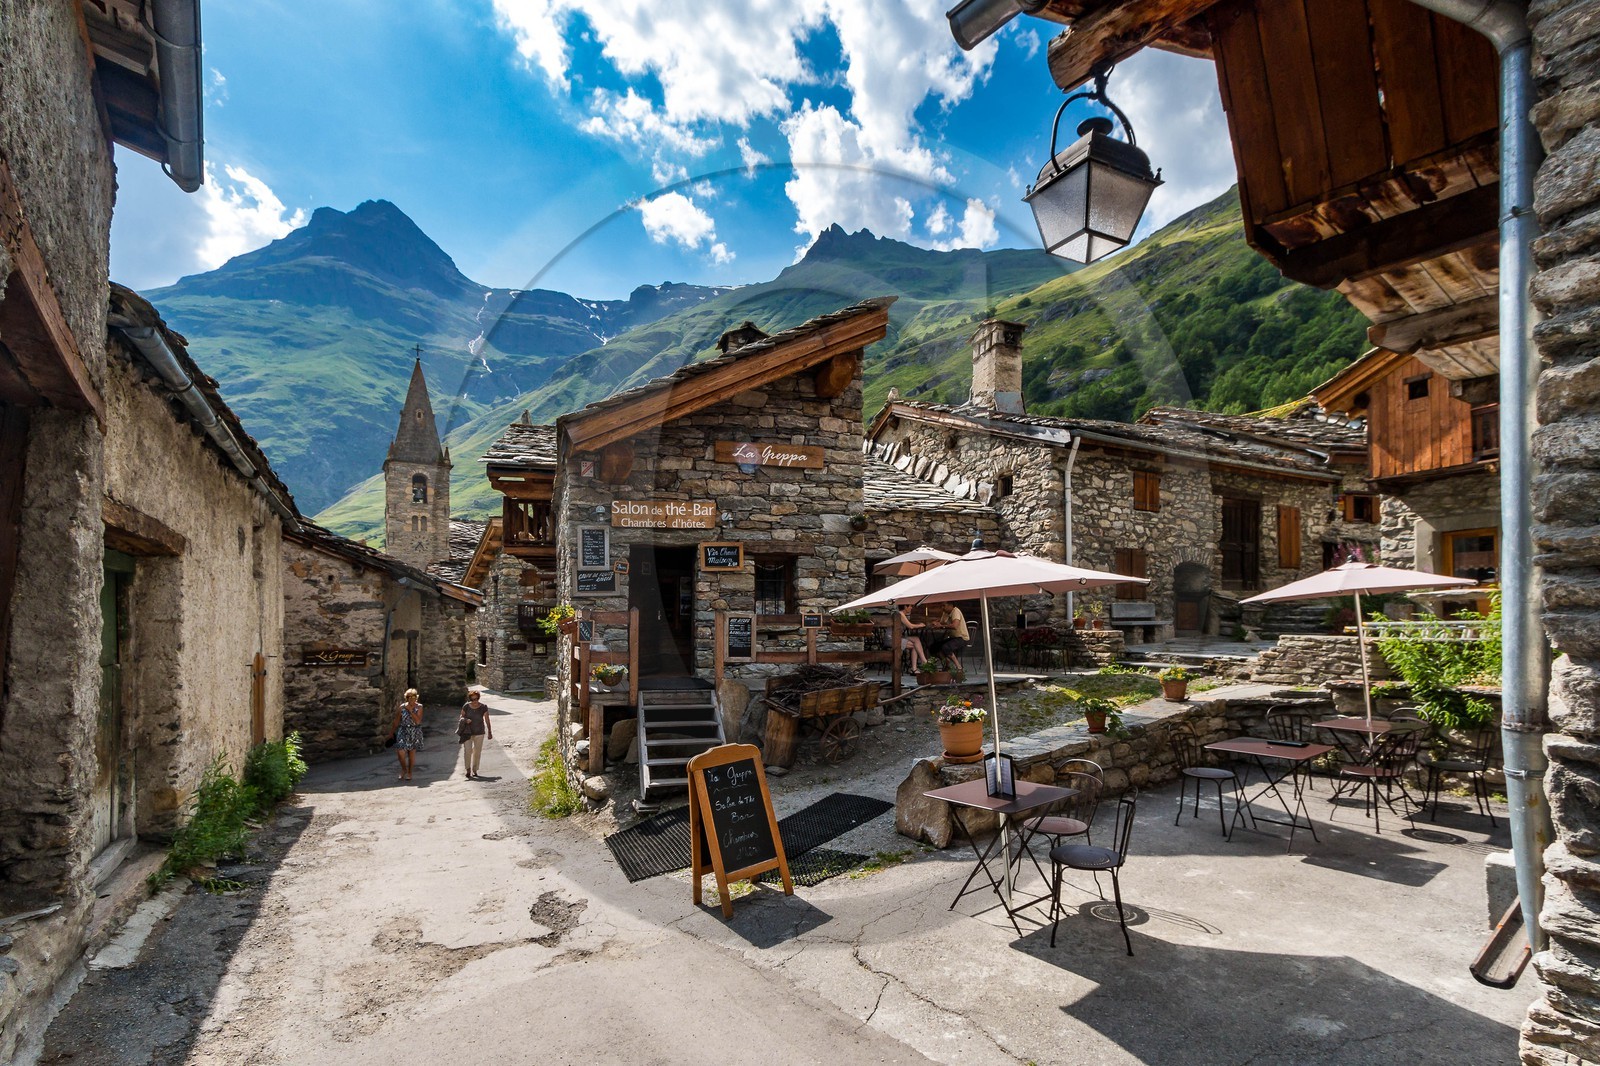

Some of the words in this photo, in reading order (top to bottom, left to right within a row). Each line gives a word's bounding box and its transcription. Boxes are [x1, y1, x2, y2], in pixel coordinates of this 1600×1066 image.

[732, 443, 755, 458] La
[761, 445, 808, 466] Greppa
[611, 500, 648, 515] Salon
[651, 506, 663, 515] de
[621, 517, 667, 528] Chambres
[671, 518, 706, 528] d'hôtes
[715, 796, 737, 811] Salon
[731, 812, 754, 824] Bar
